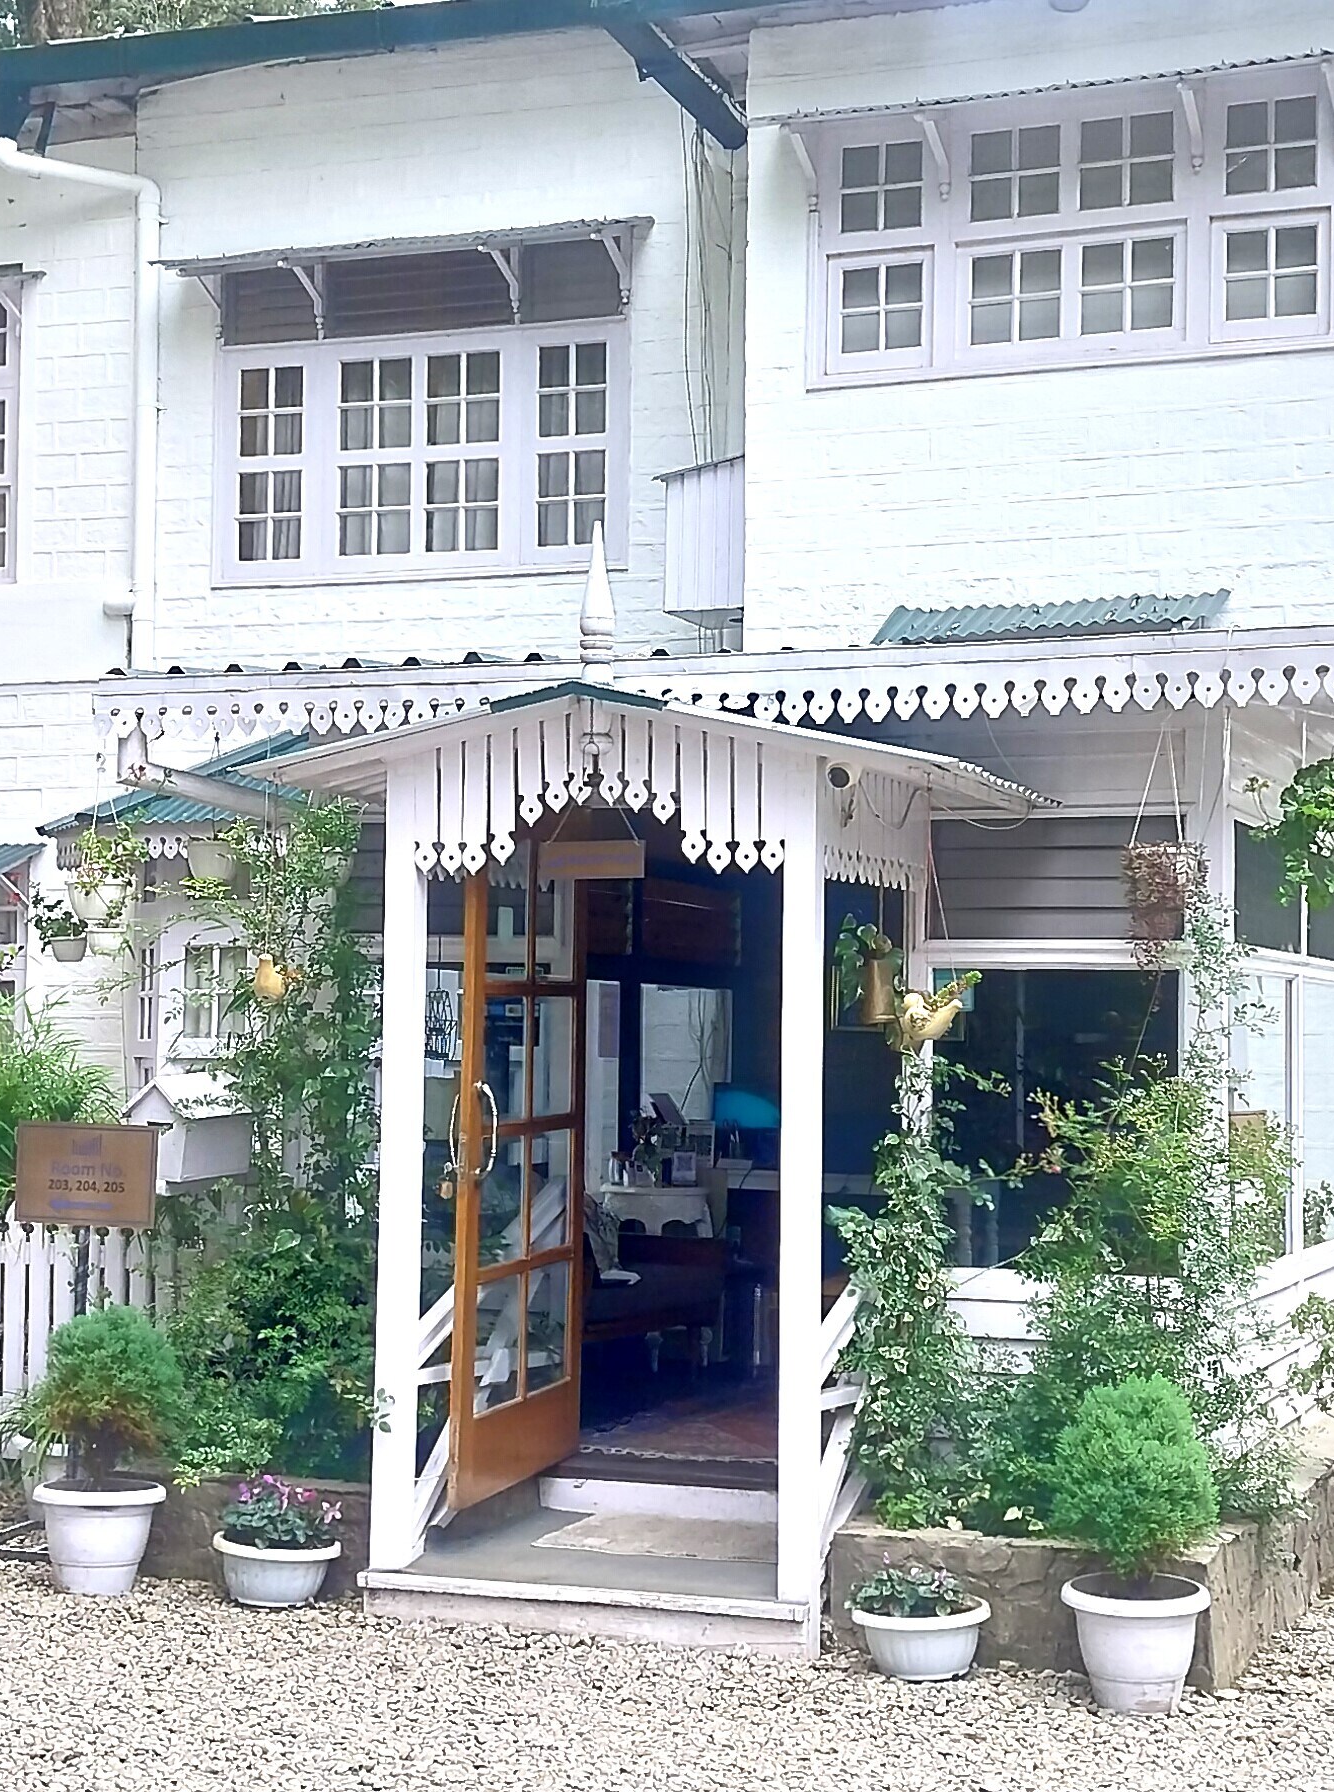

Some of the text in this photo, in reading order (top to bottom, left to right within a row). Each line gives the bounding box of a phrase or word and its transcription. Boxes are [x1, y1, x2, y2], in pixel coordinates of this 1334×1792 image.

[51, 1161, 96, 1176] Room
[48, 1179, 126, 1194] 203, 204, 205
